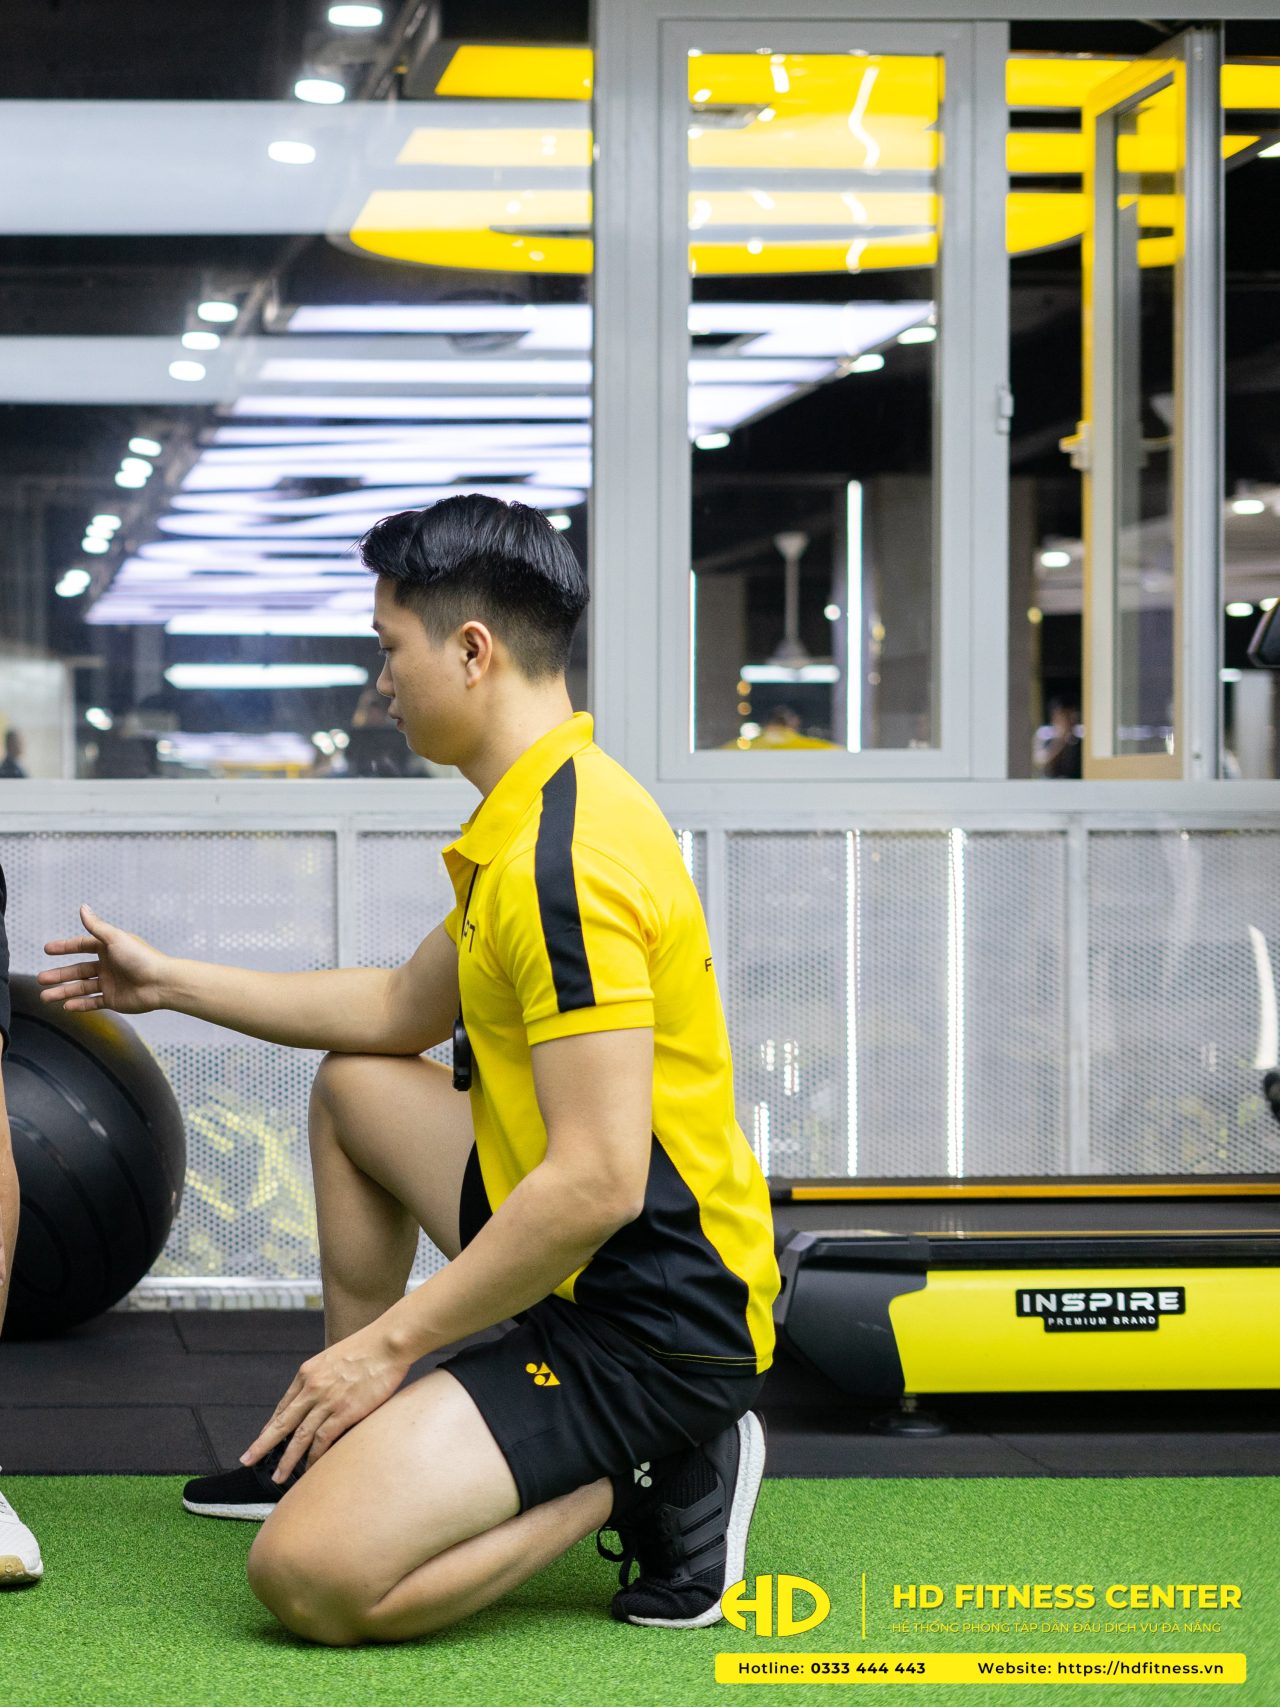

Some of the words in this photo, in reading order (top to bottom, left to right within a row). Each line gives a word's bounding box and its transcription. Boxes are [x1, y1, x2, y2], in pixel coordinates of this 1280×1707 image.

[1022, 1291, 1180, 1313] INSPIRE
[1047, 1316, 1107, 1326] PREMIUM
[1113, 1315, 1156, 1325] BRAND
